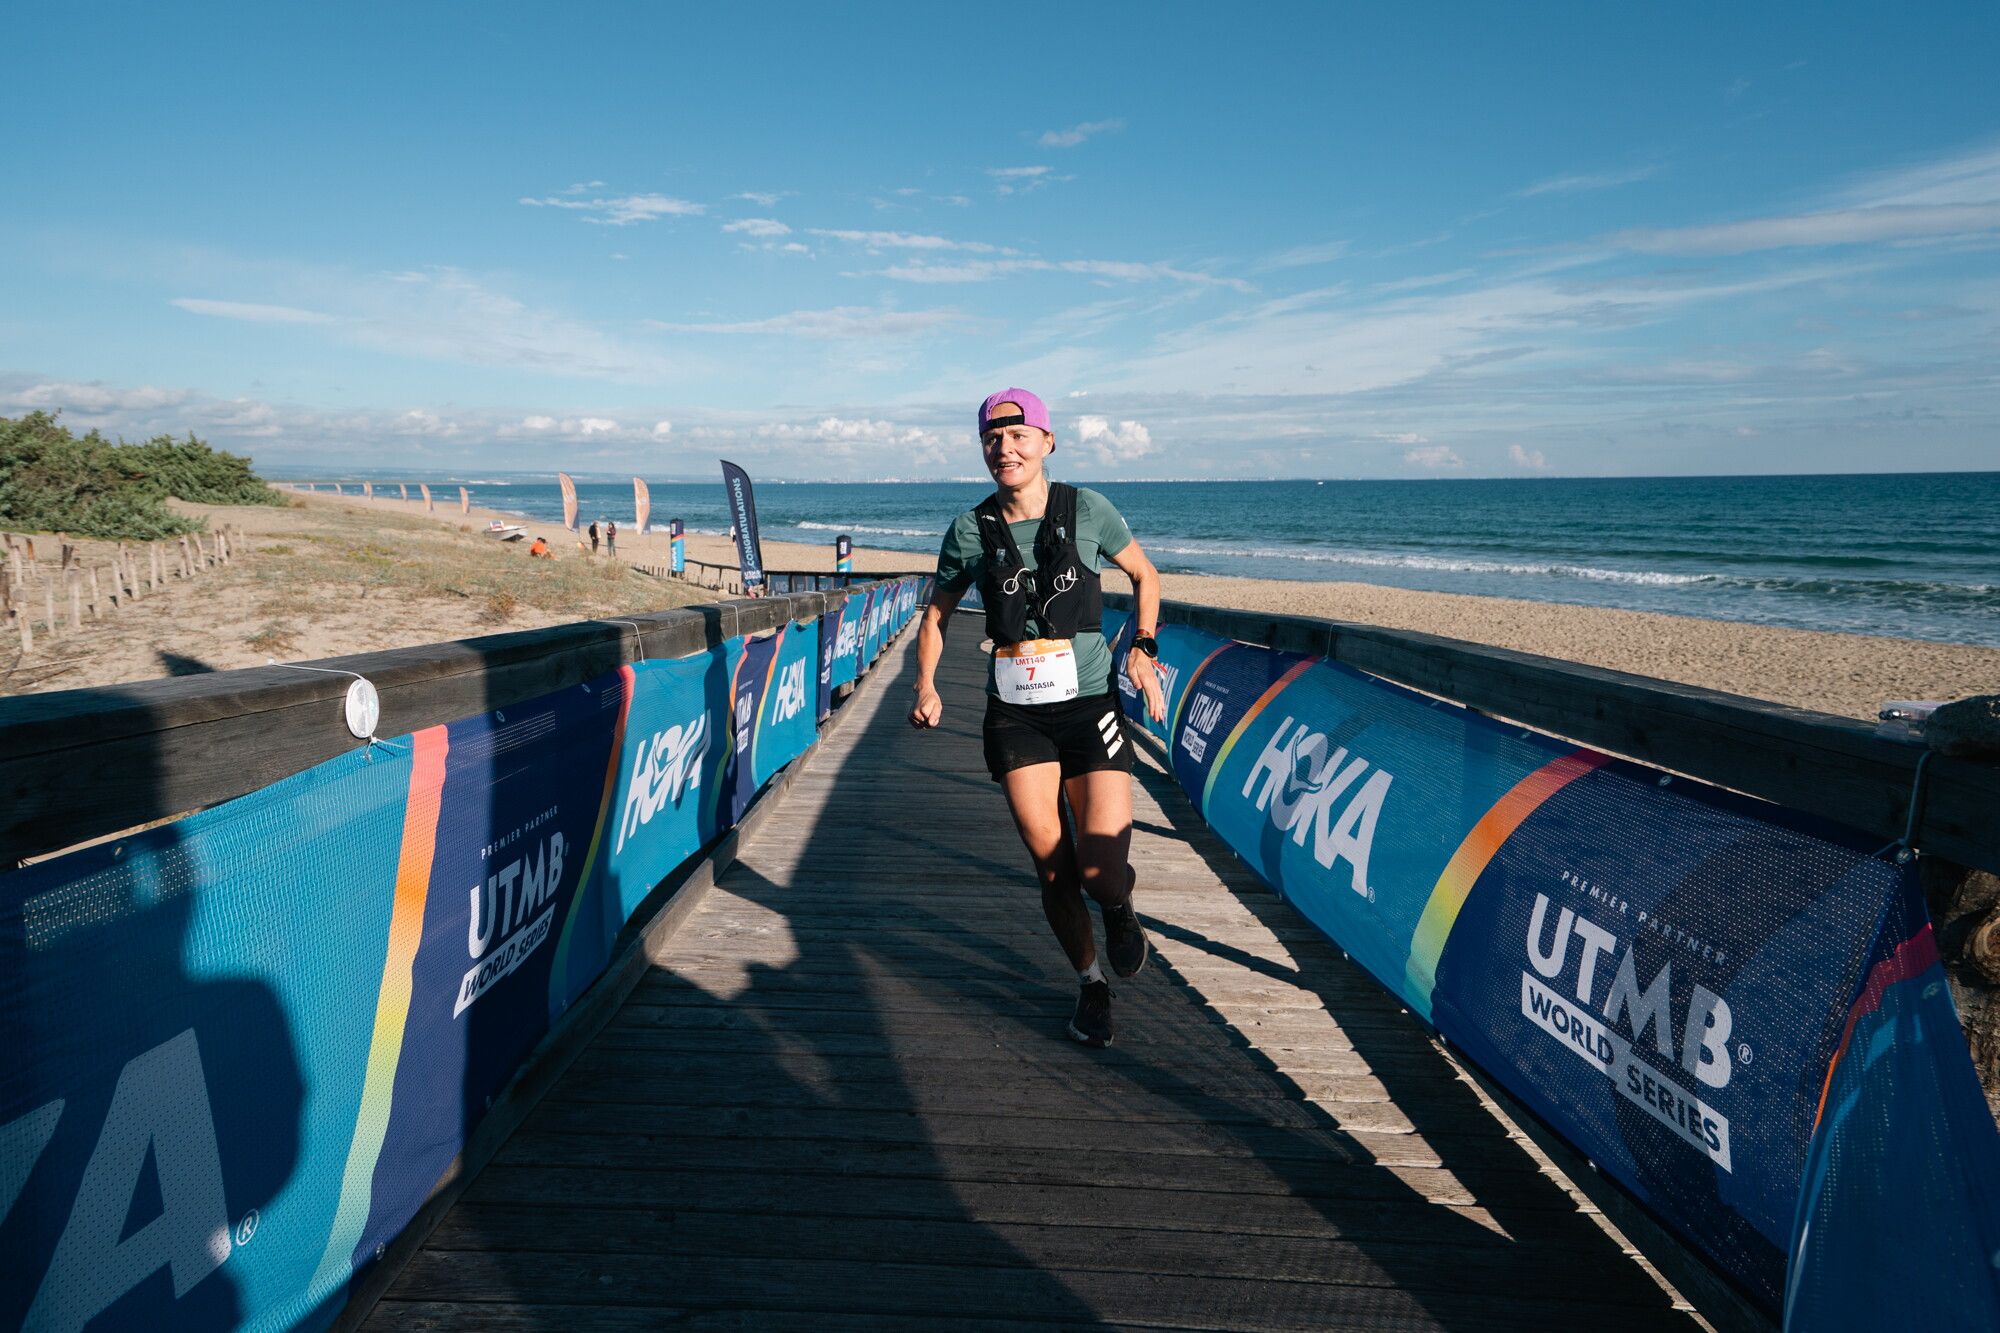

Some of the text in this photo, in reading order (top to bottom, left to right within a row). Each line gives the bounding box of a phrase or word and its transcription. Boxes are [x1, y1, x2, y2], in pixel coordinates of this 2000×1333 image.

[733, 477, 755, 566] CONGRATULATIONS
[1015, 655, 1046, 666] LMT140
[1015, 680, 1055, 691] ANASTASIA
[1025, 667, 1036, 681] 7
[1188, 692, 1224, 735] UTMB
[616, 709, 712, 856] HOKA
[1241, 715, 1394, 898] HOKA
[481, 805, 559, 860] PREMIER PARTNER
[468, 831, 564, 960] UTMB
[1561, 871, 1726, 967] PREMIER PARTNER
[463, 917, 549, 1001] WORLD SERIES
[1526, 891, 1733, 1089] UTMB
[1528, 984, 1721, 1153] WORLD SERIES
